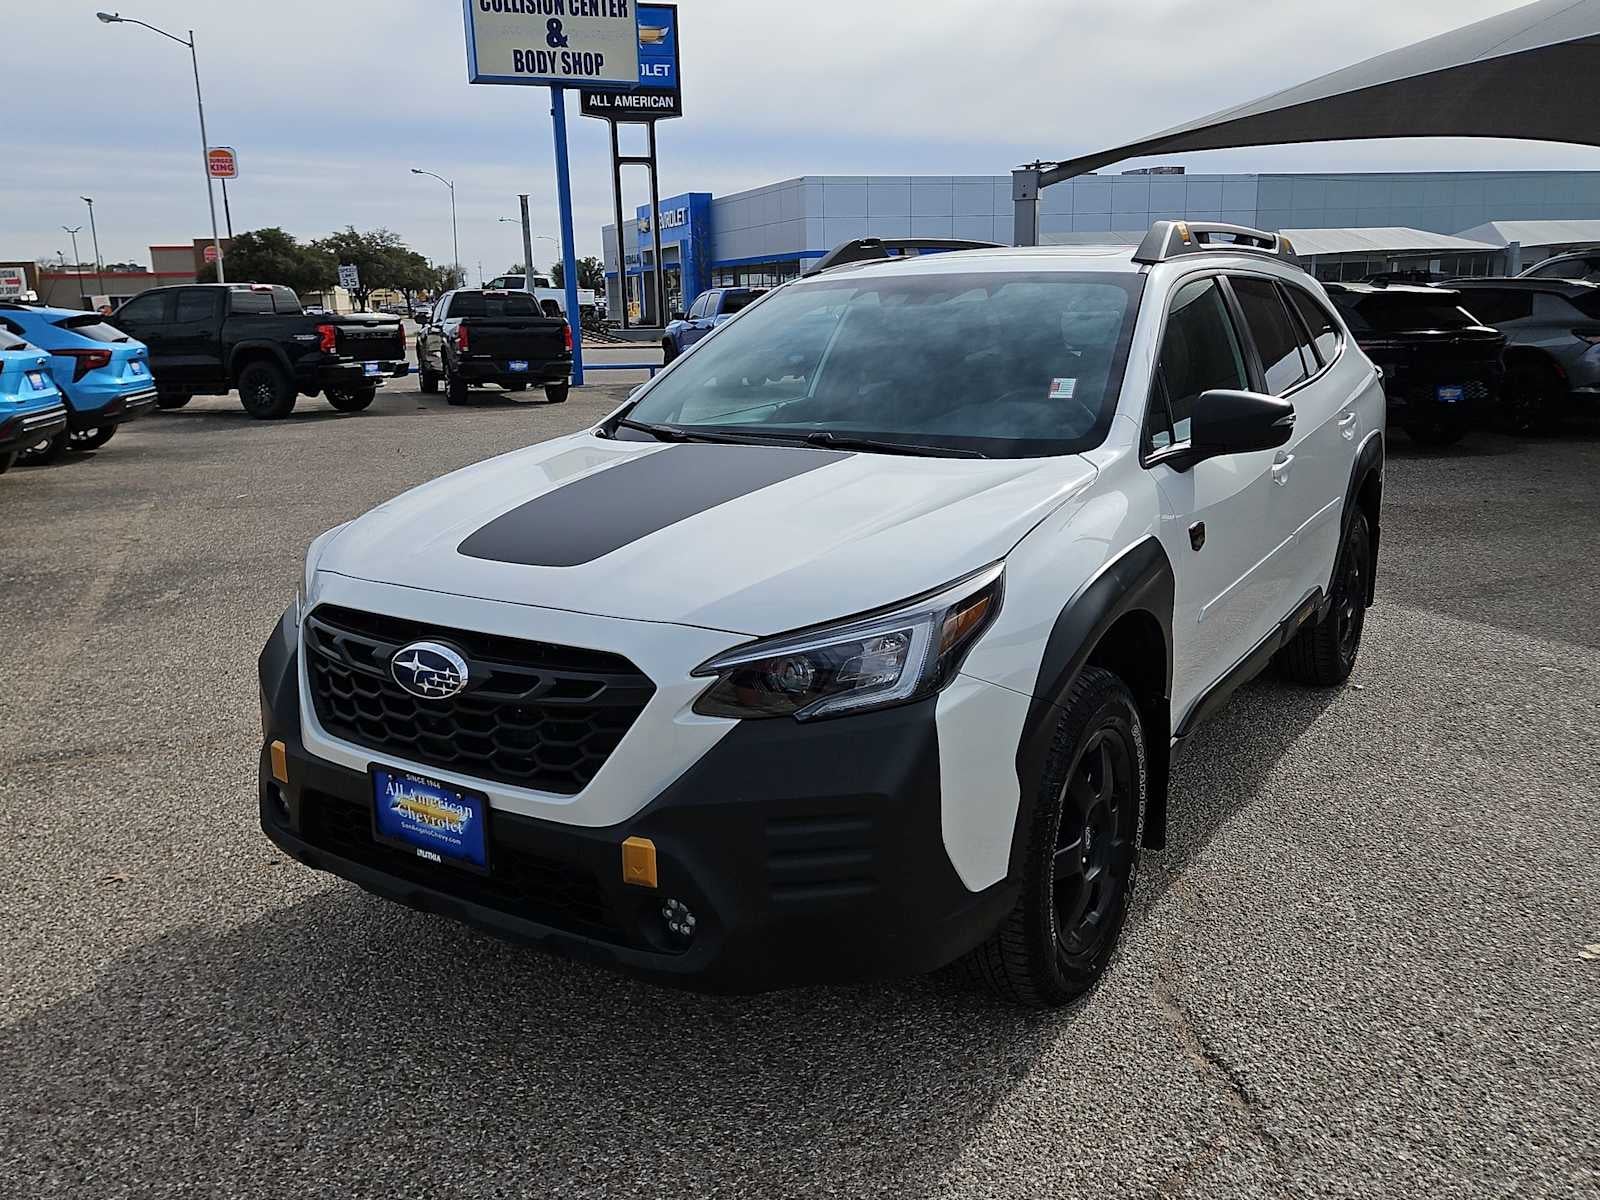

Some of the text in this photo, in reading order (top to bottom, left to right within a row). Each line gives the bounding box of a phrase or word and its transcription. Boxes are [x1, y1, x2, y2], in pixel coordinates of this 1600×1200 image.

[480, 0, 628, 18] COLLISION CENTER
[546, 18, 569, 48] &
[513, 50, 604, 76] BODY SHOP
[589, 95, 674, 108] ALL AMERICAN
[343, 278, 357, 287] 35
[406, 774, 427, 785] SINCE
[385, 782, 473, 818] All American
[398, 803, 464, 834] Chevrolet
